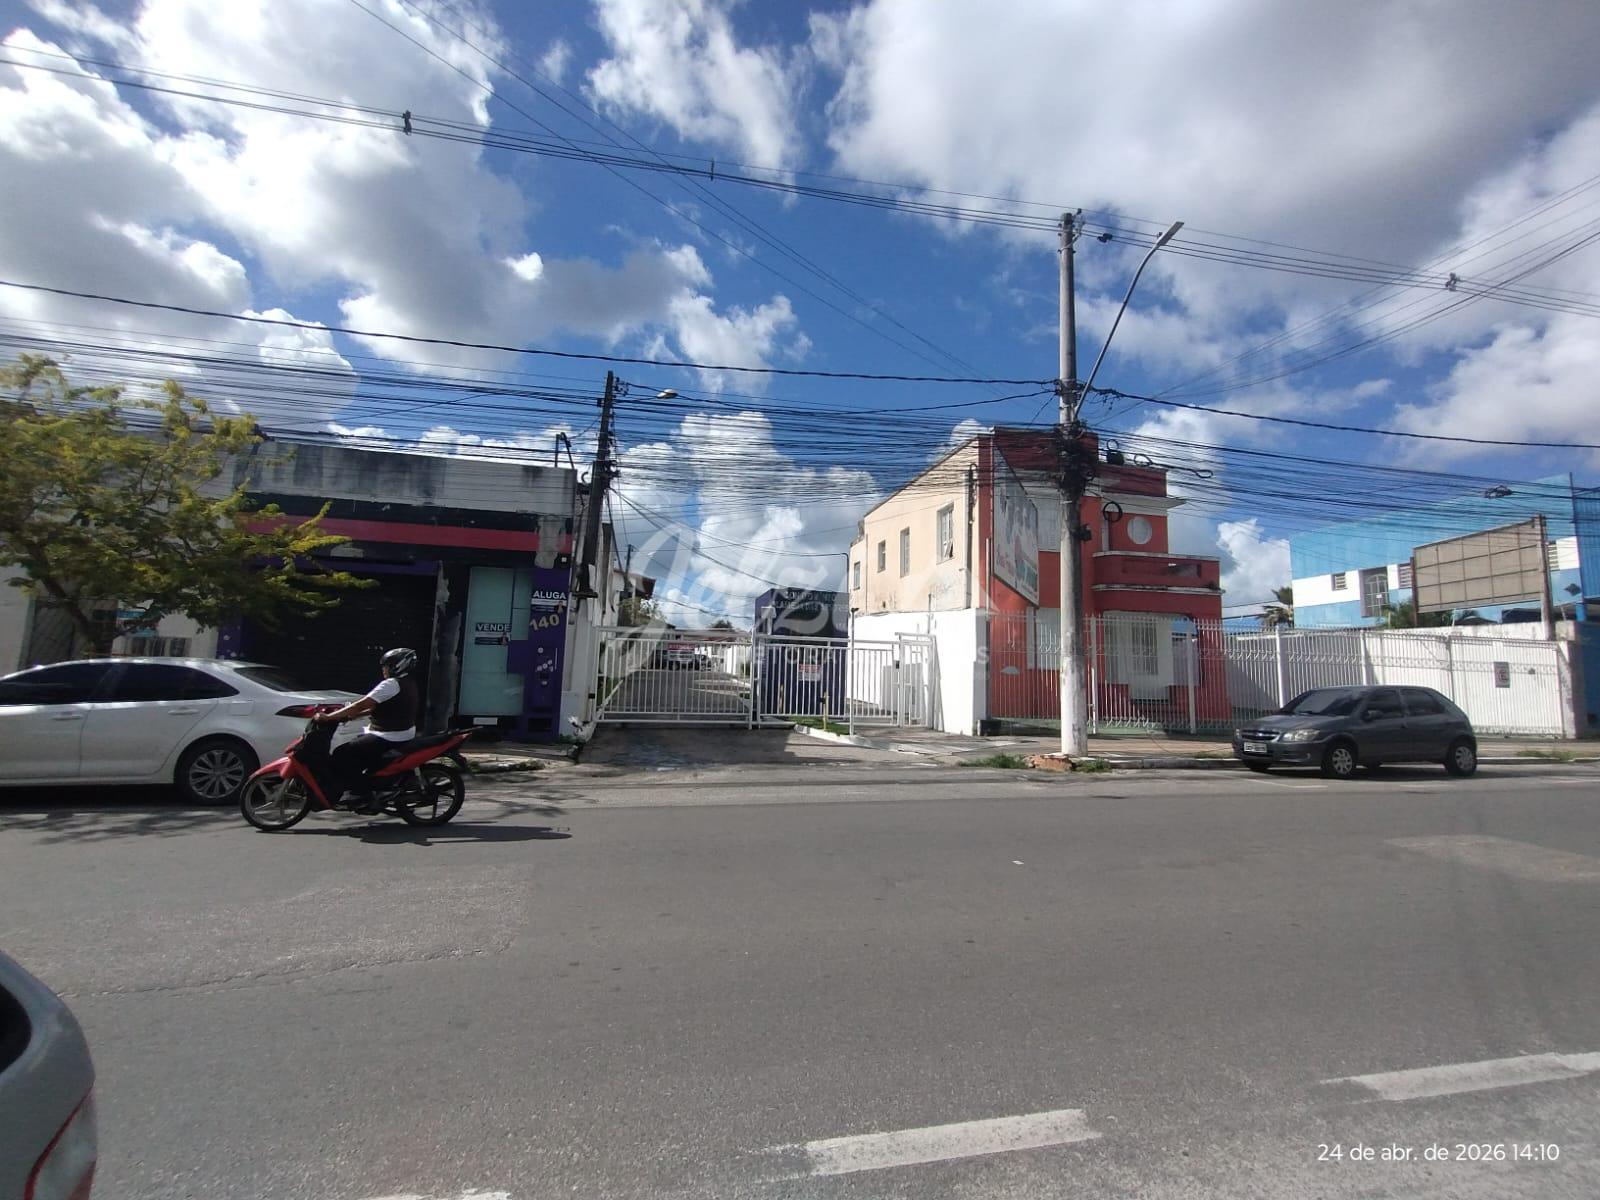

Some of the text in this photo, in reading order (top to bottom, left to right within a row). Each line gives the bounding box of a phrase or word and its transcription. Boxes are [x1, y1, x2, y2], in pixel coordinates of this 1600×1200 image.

[533, 590, 567, 600] ALUGA
[477, 623, 511, 632] VENDE
[529, 614, 560, 631] 140
